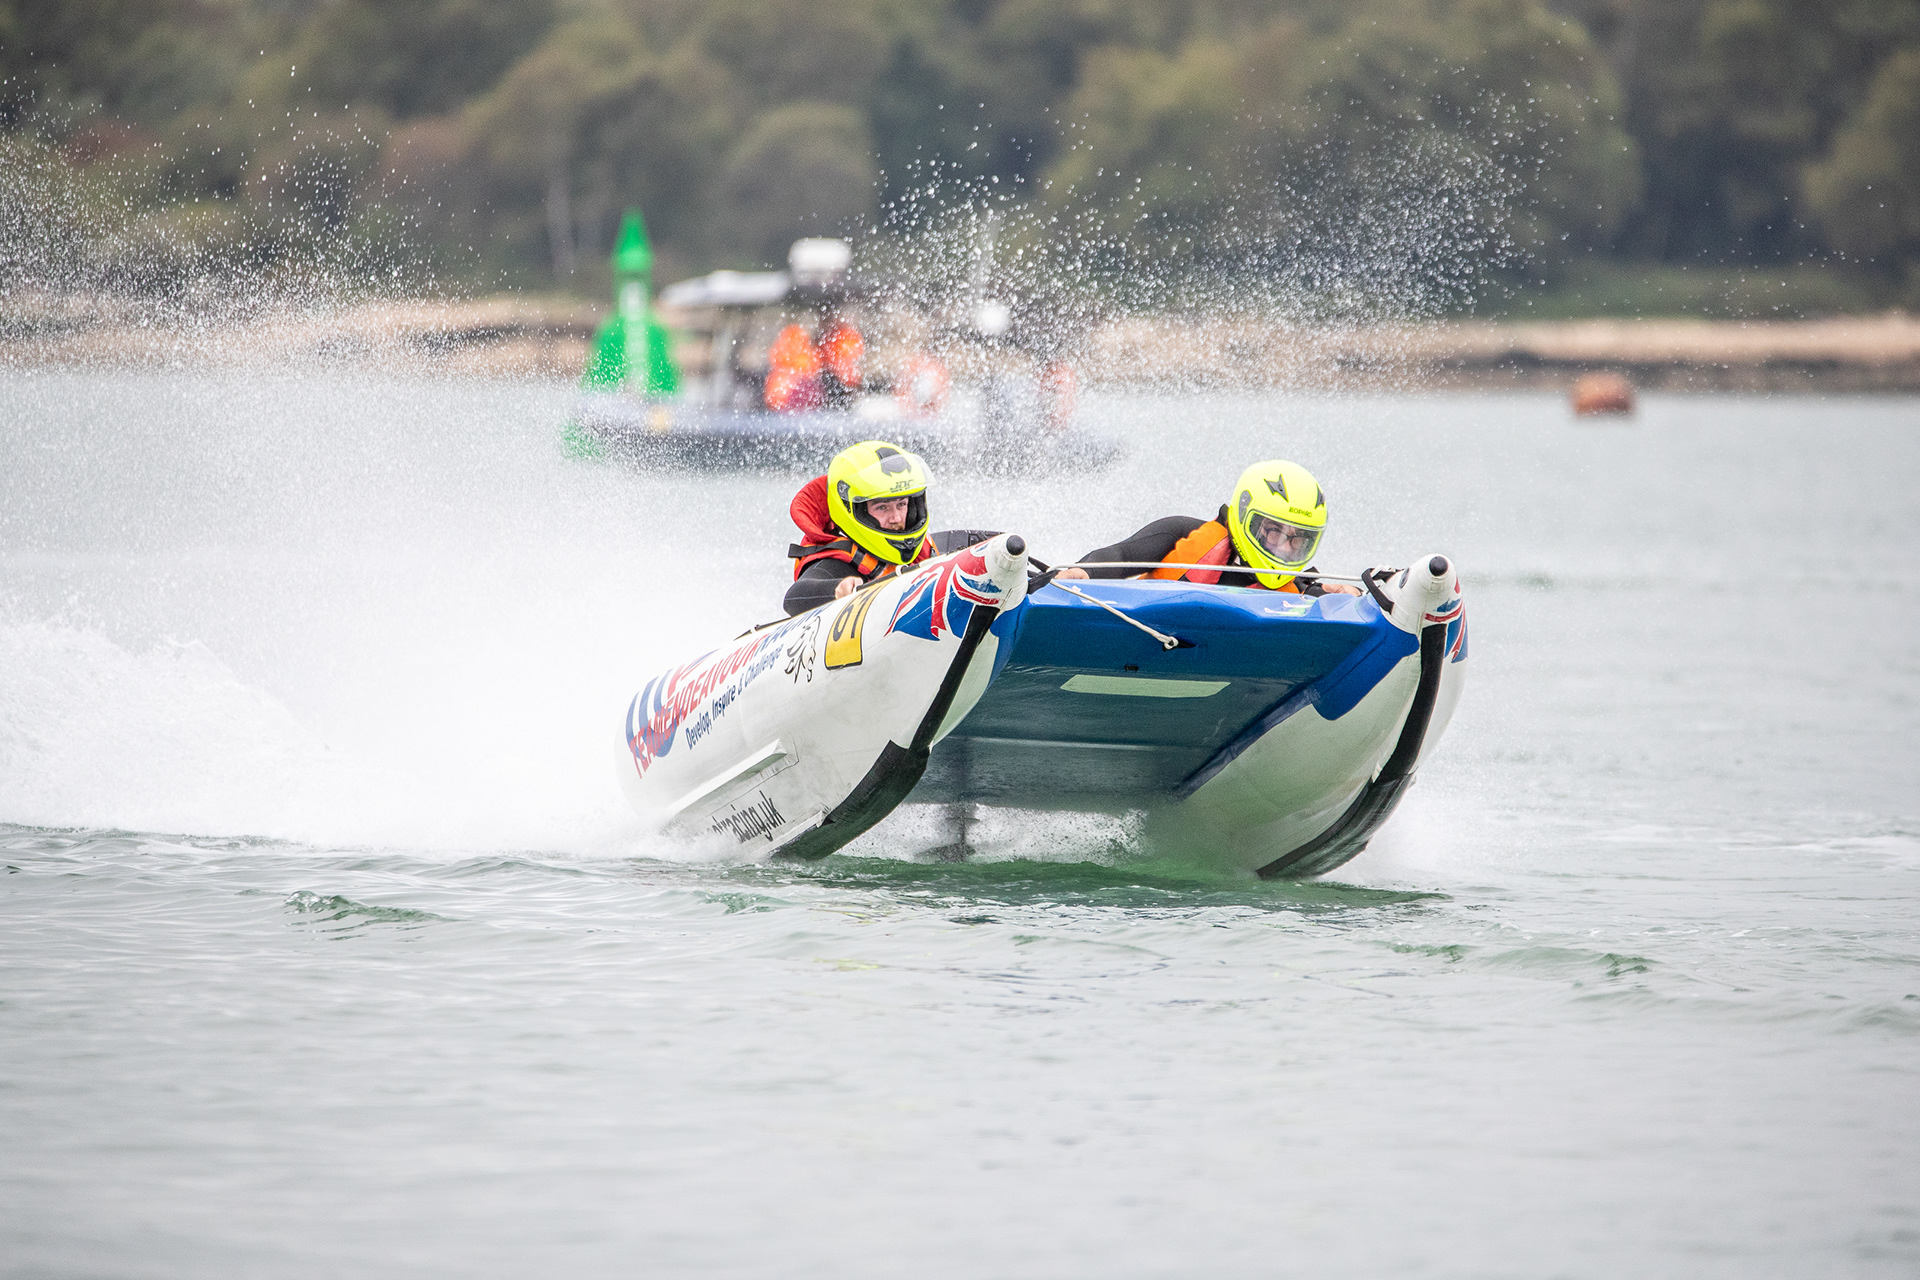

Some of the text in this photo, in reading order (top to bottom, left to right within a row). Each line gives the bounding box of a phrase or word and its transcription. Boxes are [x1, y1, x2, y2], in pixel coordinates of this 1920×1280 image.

[685, 643, 784, 750] Develop, Inspire & Challenge
